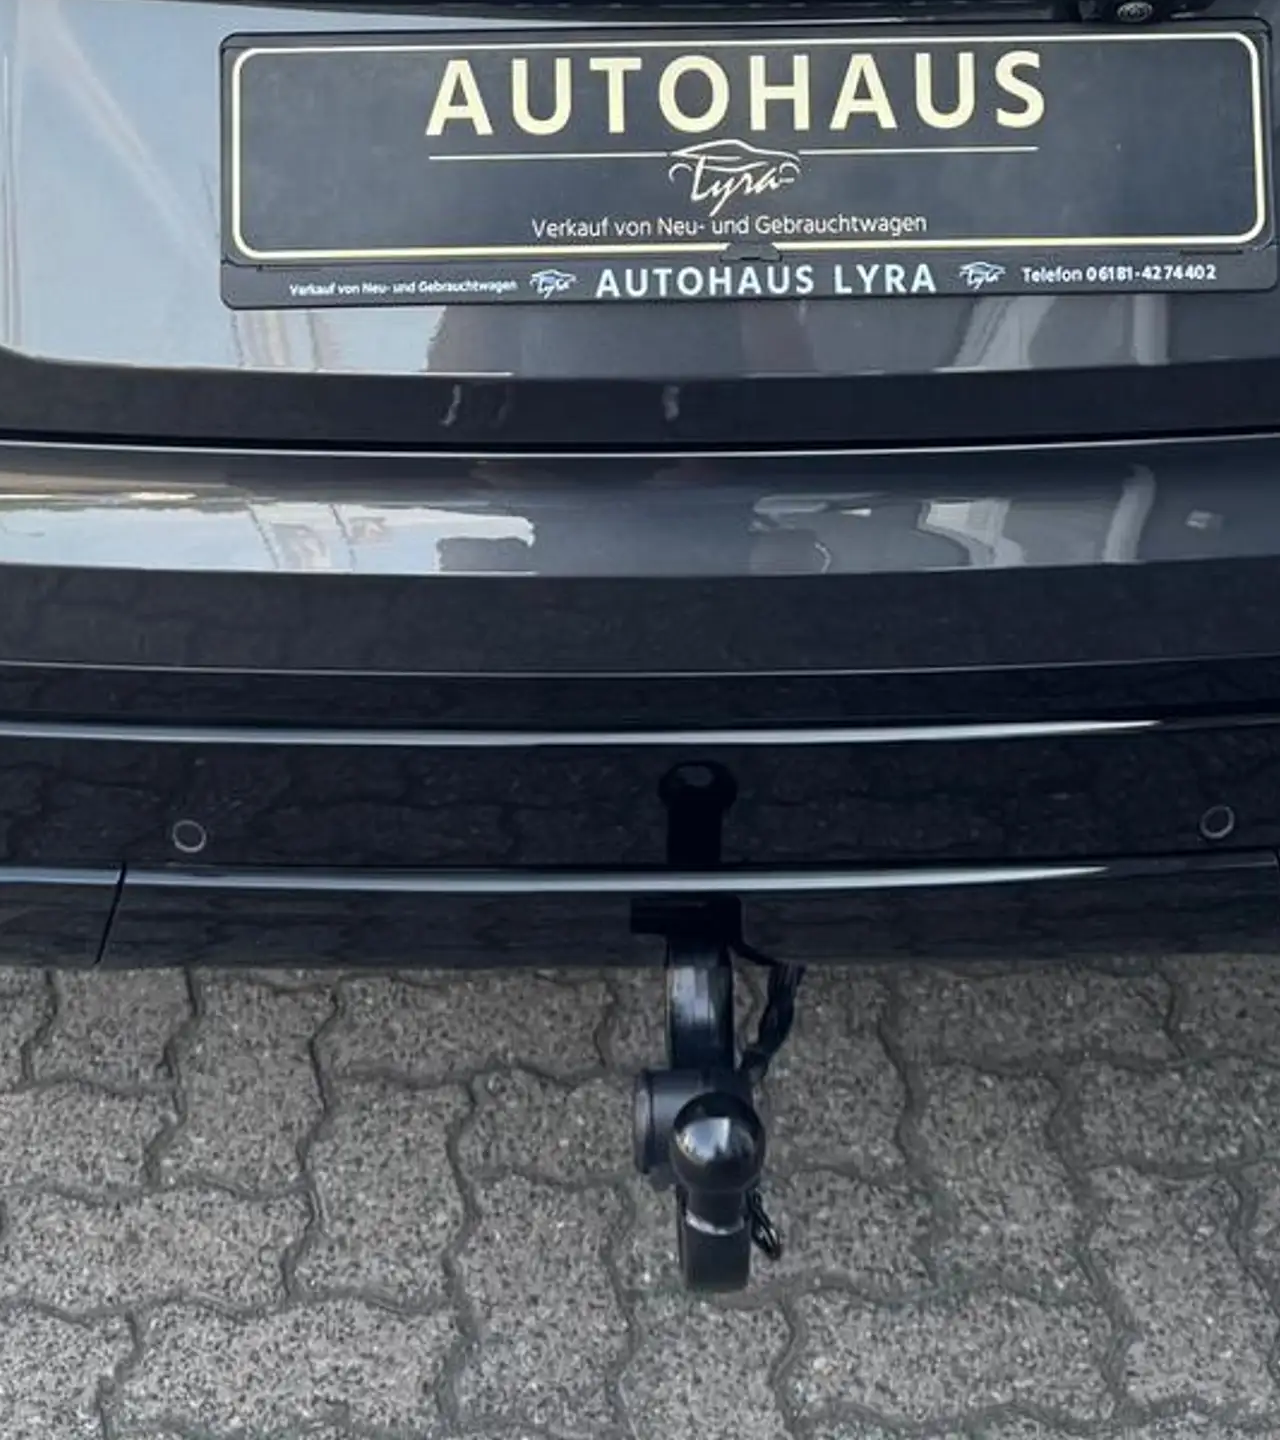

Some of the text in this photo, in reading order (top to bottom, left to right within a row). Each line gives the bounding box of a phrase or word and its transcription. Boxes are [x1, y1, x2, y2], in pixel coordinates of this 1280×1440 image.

[425, 50, 1045, 136] AUTOHAUS
[531, 213, 928, 237] Verkauf von Neu- und Gebrauchtwagen
[595, 263, 936, 298] AUTOHAUS LYRA
[1022, 266, 1083, 283] Telefon
[289, 277, 518, 297] Verkauf von Neu- und Gebrauchtwagen
